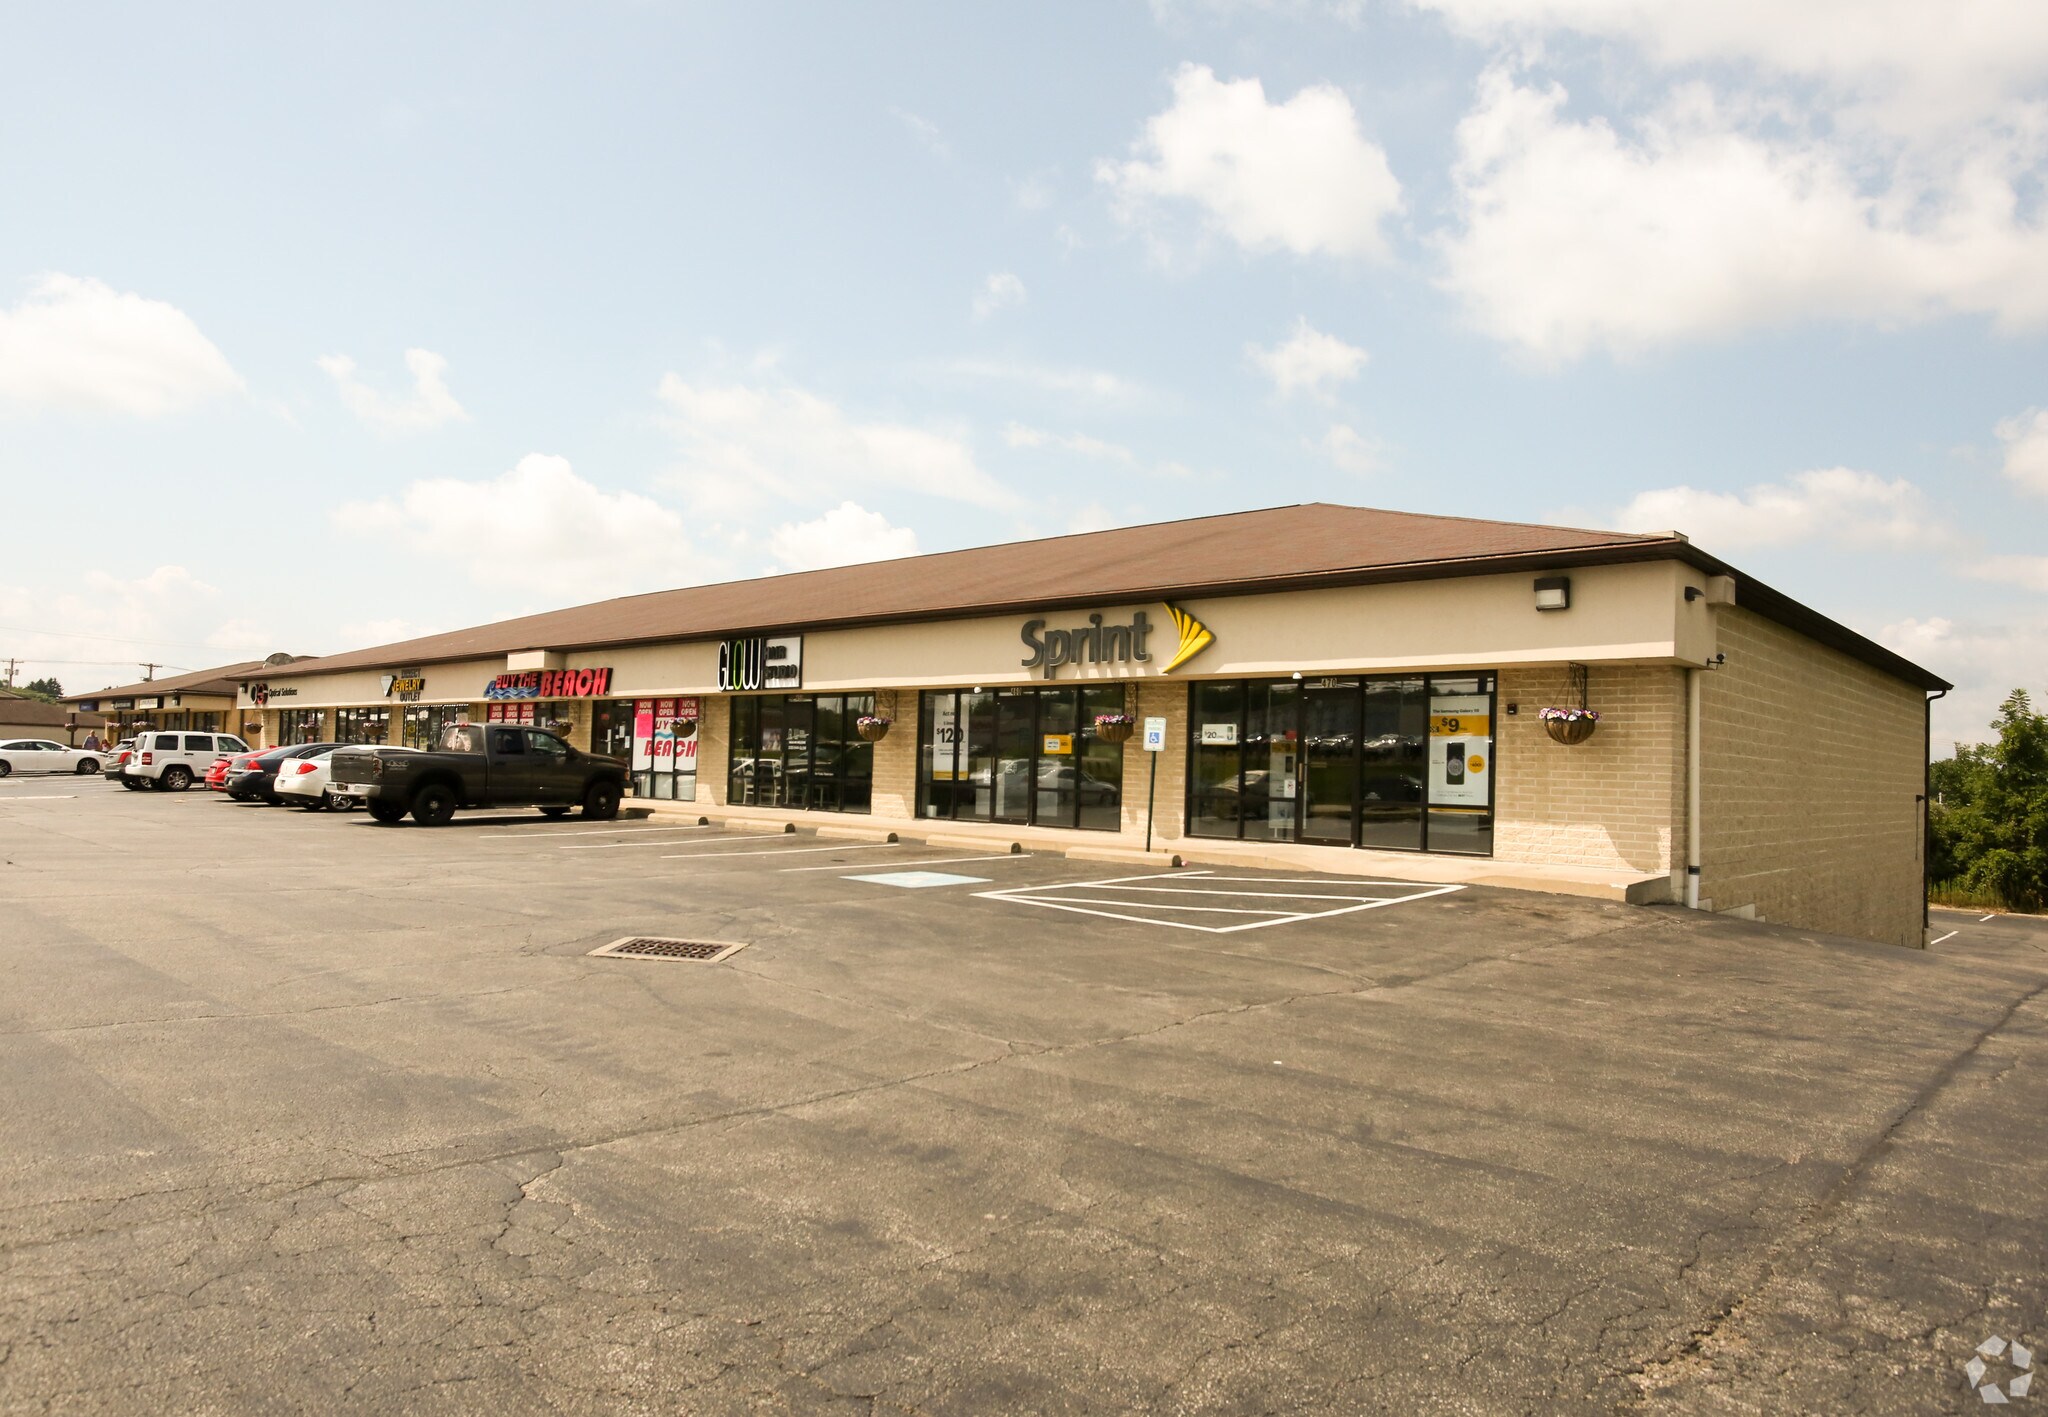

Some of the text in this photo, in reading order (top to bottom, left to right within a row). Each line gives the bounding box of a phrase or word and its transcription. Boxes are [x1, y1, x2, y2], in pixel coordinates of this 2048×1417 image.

[1021, 612, 1153, 679] Sprint
[764, 646, 787, 660] HAIR
[717, 638, 762, 691] GLOW
[764, 664, 798, 679] STUDIO
[392, 679, 421, 692] JEWELRY
[495, 668, 610, 697] BUY THE BEACH
[1321, 678, 1338, 688] 470
[269, 687, 298, 698] Optical Solutions
[400, 692, 421, 702] OUTLET
[682, 700, 696, 708] NOW
[659, 708, 674, 716] OPEN
[1441, 716, 1460, 733] $9
[1204, 731, 1217, 739] $20
[644, 740, 697, 758] BEACH
